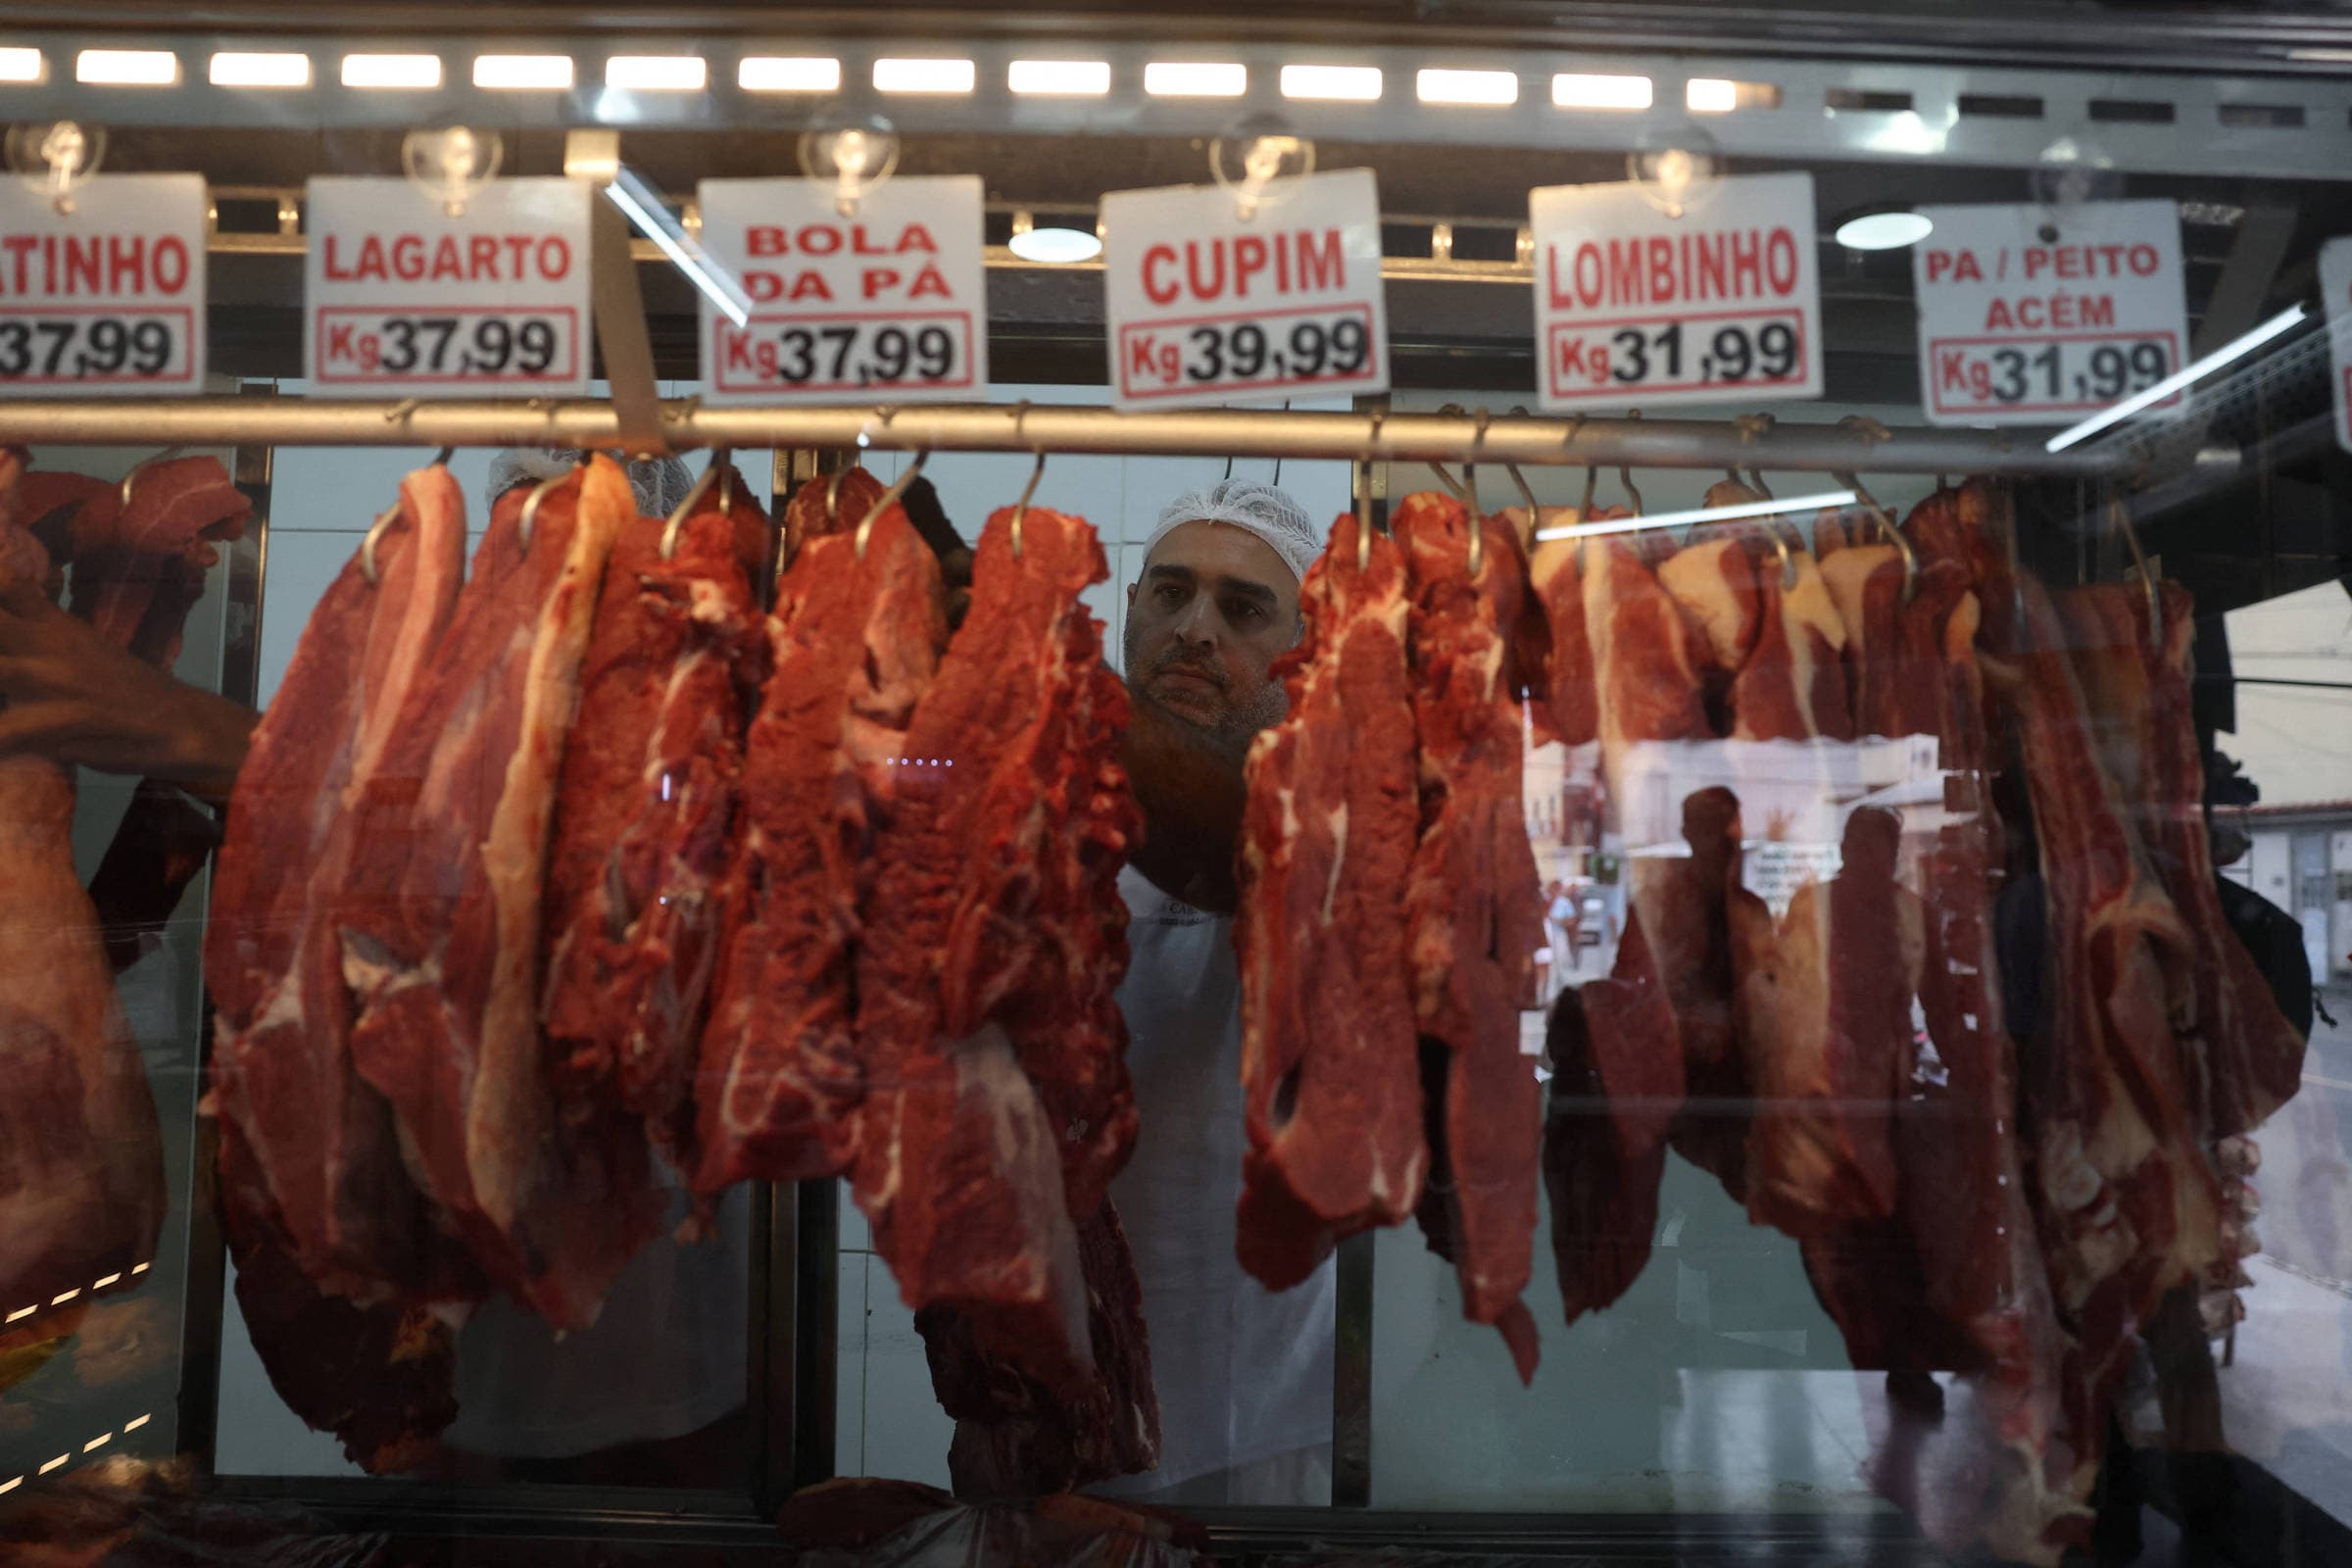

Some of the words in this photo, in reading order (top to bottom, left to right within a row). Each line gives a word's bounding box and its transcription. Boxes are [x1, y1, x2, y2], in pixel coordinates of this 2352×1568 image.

[0, 235, 189, 295] TINHO
[323, 234, 571, 282] LAGARTO
[746, 223, 938, 256] BOLA
[1141, 227, 1345, 306] CUPIM
[1547, 226, 1798, 311] LOMBINHO
[2024, 242, 2160, 279] PEITO
[743, 270, 833, 302] DA
[0, 320, 172, 379] 37,99
[381, 318, 557, 376] 37,99
[779, 326, 954, 386] 37,99
[1187, 318, 1367, 382] 39,99
[1612, 323, 1797, 383] 31,99
